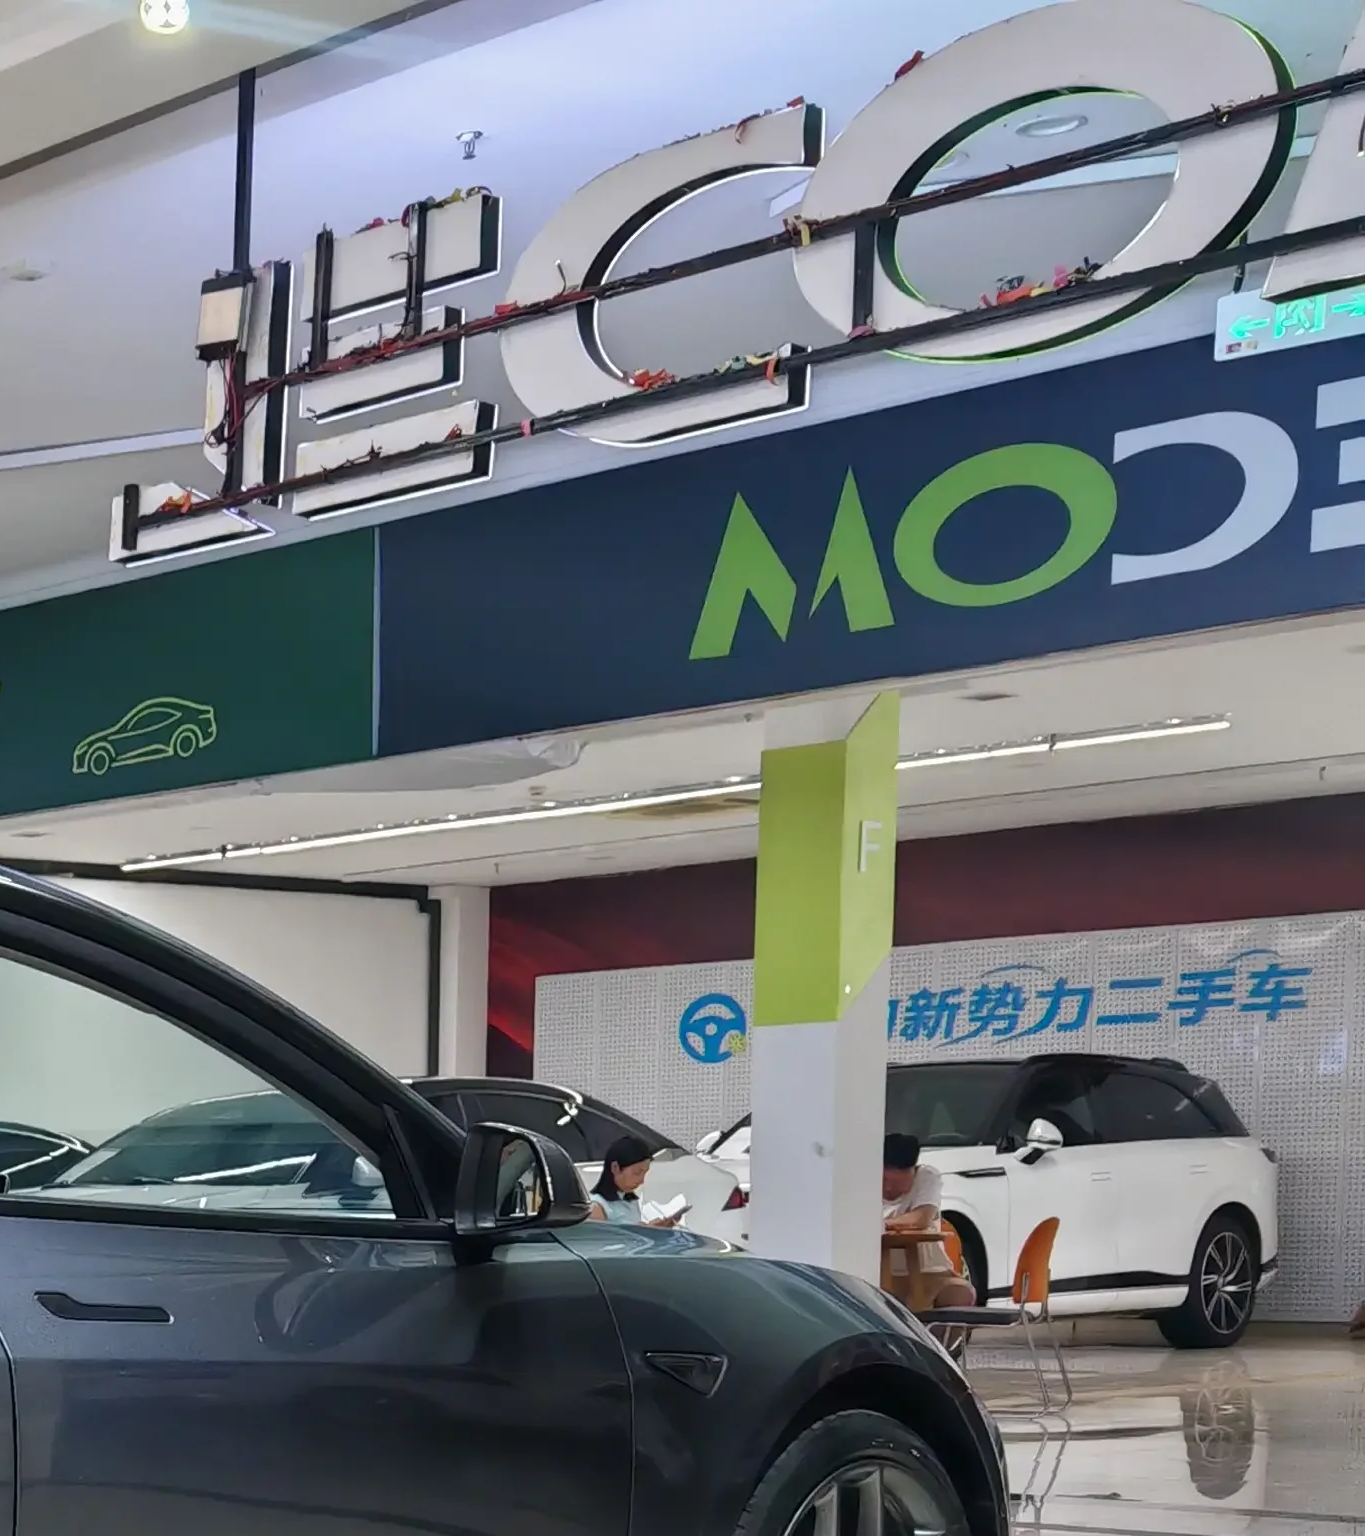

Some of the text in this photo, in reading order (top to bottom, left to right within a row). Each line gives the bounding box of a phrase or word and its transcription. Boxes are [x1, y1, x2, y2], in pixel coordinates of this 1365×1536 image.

[858, 820, 882, 873] F
[887, 962, 1313, 1044] 新势力二手车
